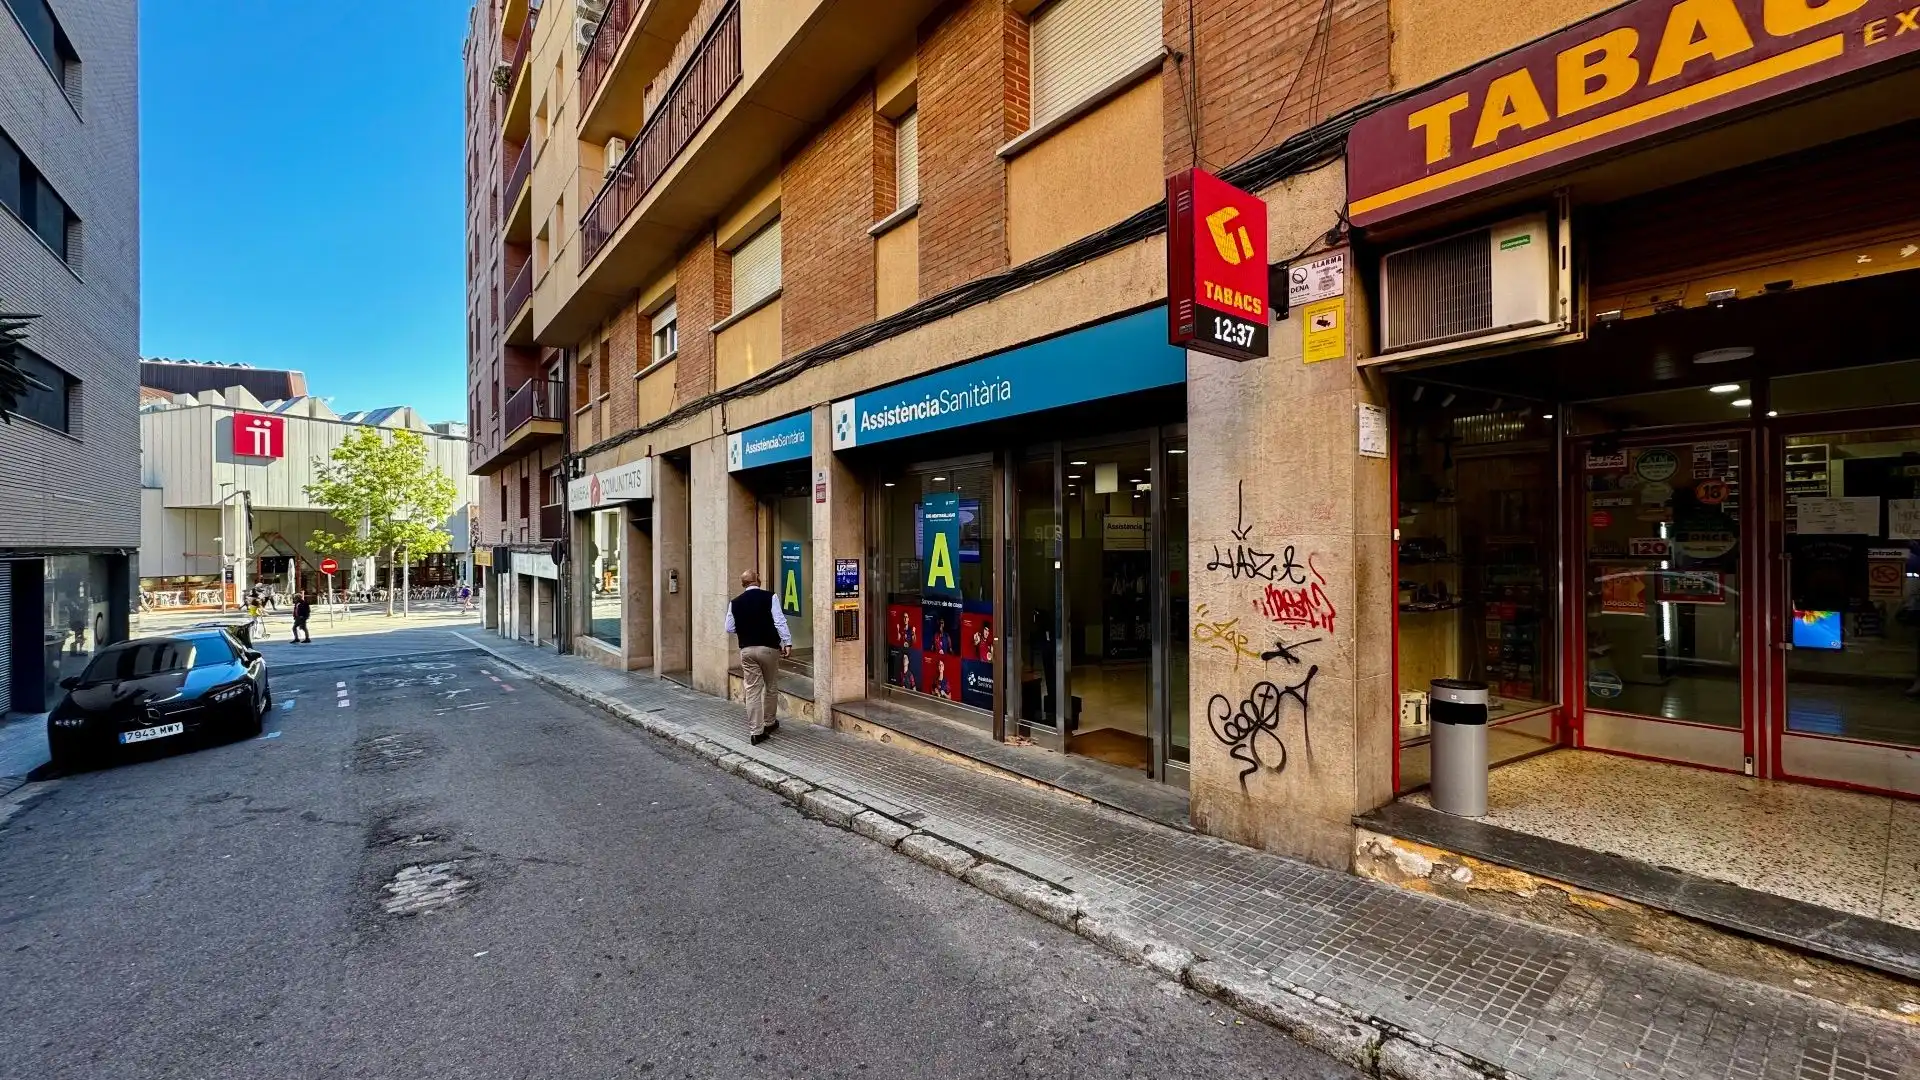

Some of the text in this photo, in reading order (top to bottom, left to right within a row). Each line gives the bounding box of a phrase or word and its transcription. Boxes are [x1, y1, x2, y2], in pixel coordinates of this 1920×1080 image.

[1311, 255, 1342, 269] ALARMA
[1204, 280, 1262, 315] TABACS
[1290, 284, 1309, 293] DENA
[1214, 316, 1255, 347] 12:37
[928, 532, 956, 589] A
[784, 569, 800, 612] A
[127, 723, 181, 740] 7943 MWY
